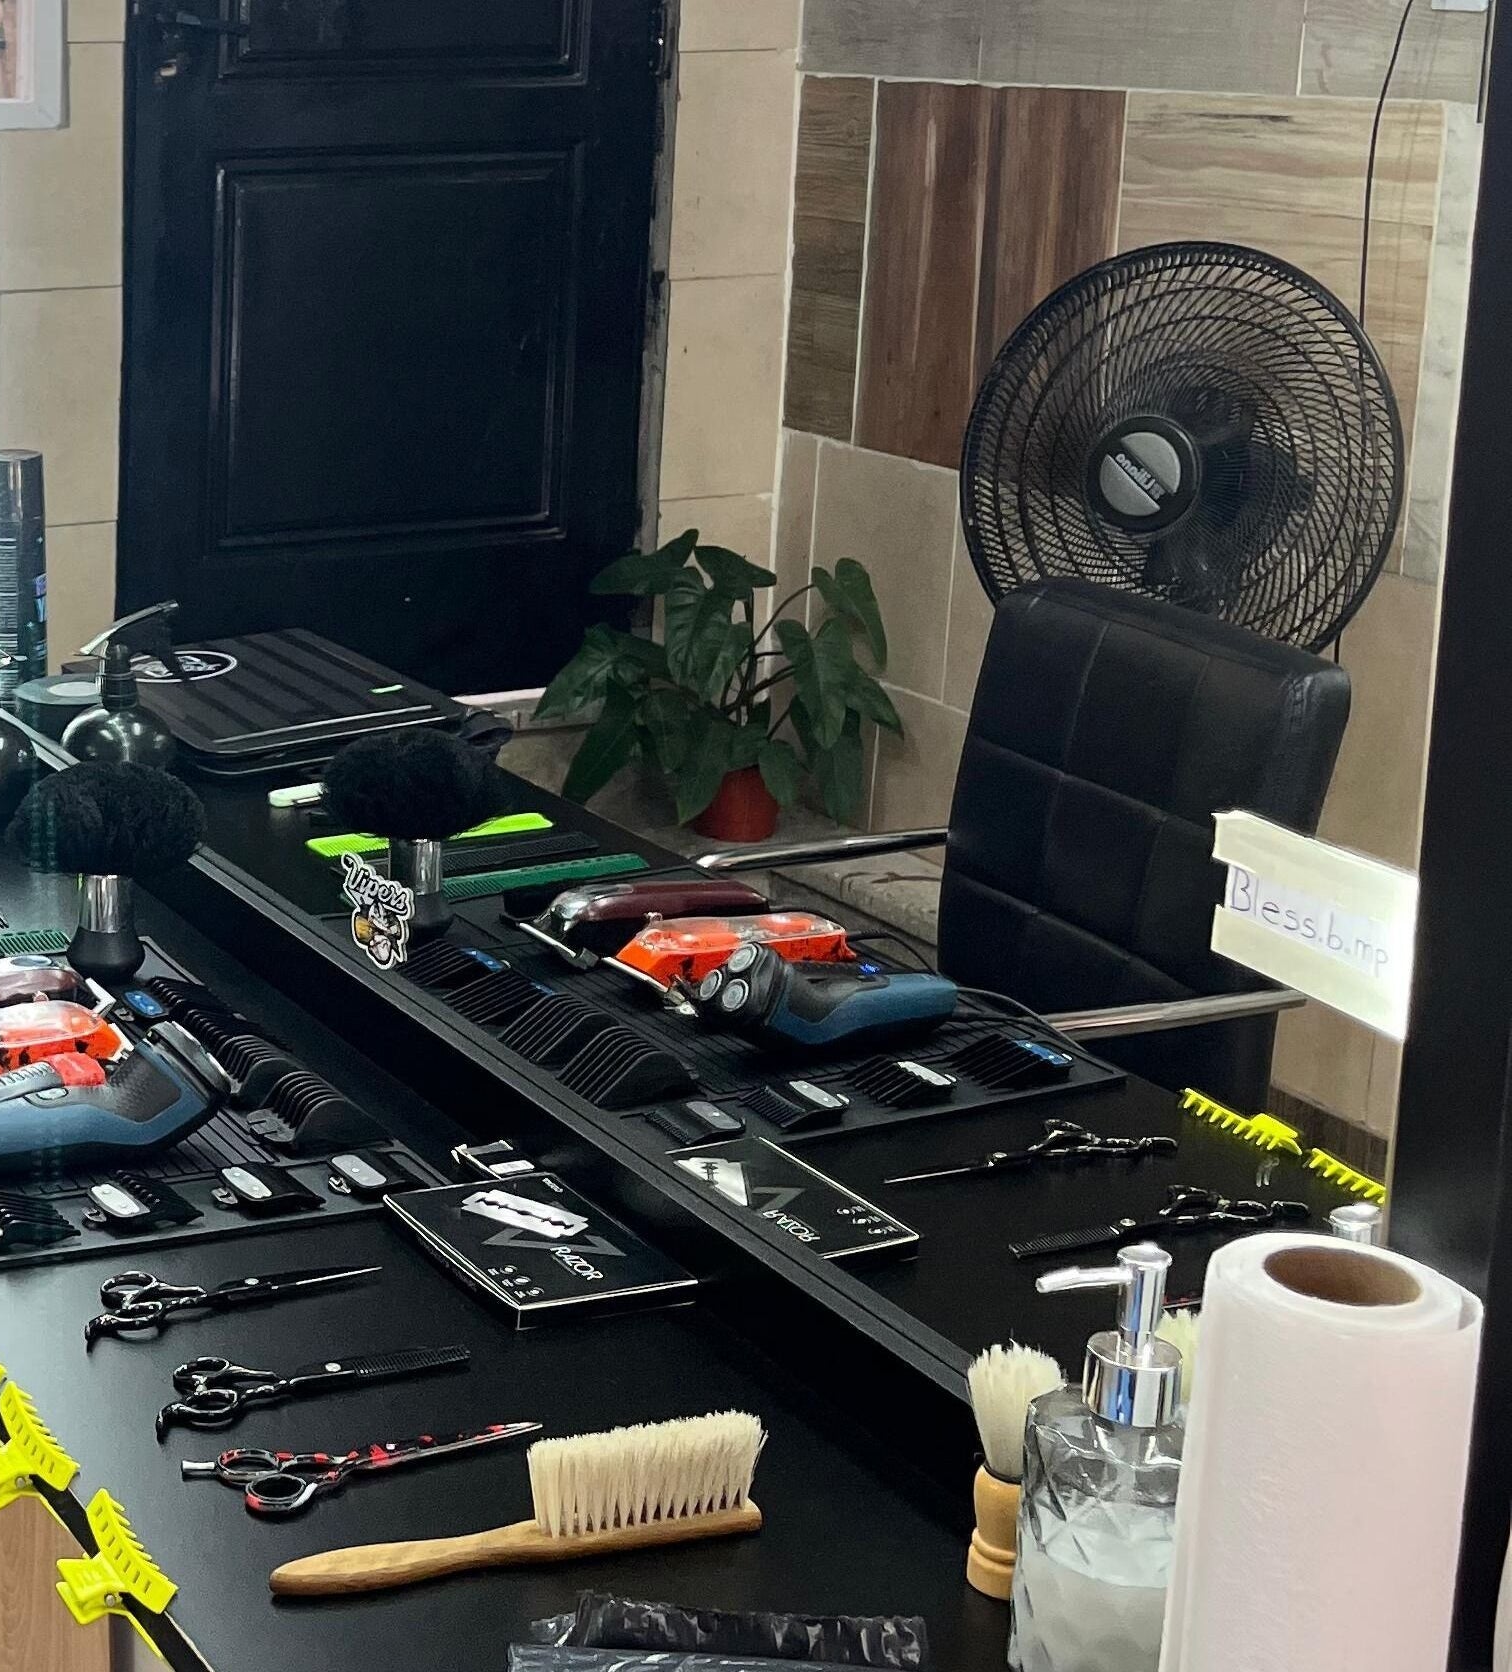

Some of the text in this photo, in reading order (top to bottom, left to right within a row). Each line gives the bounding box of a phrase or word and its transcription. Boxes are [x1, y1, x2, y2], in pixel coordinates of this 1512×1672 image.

[343, 854, 409, 915] Vipers
[1230, 867, 1389, 977] Bless.b.mp
[550, 1245, 604, 1281] RAZOR
